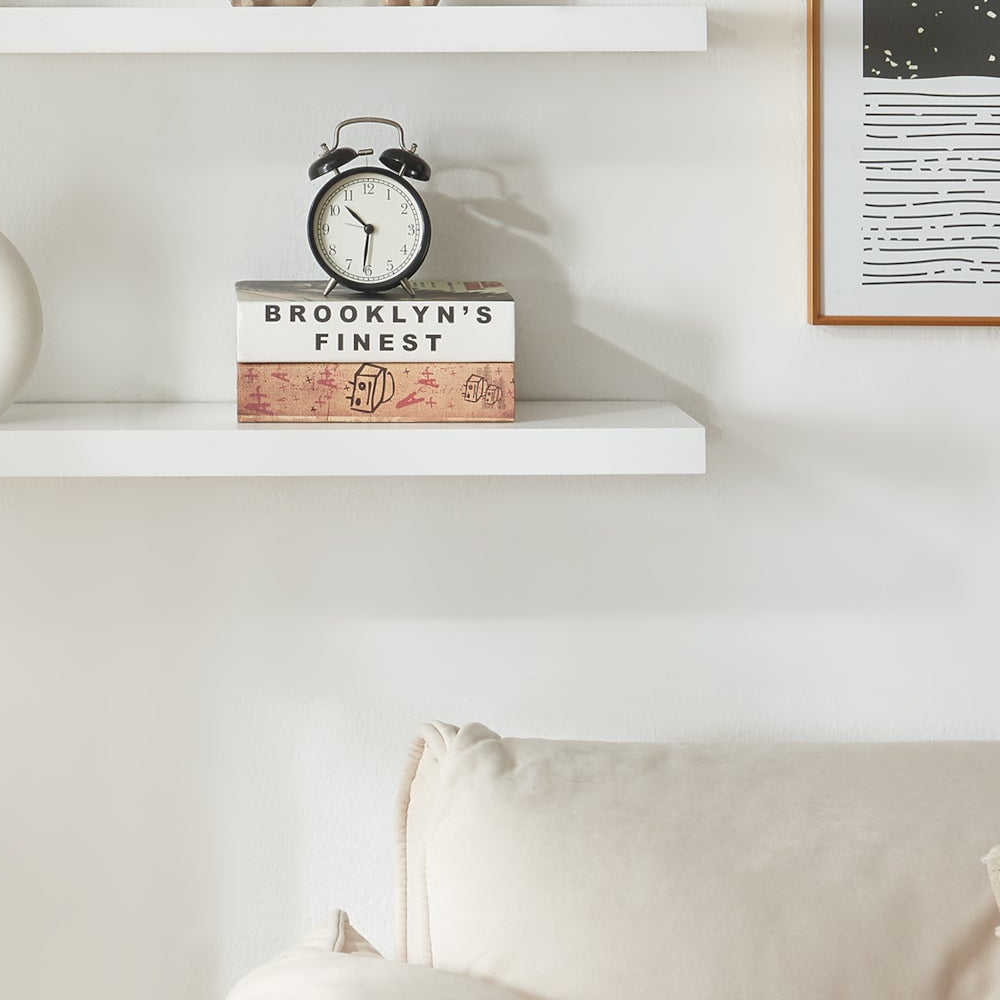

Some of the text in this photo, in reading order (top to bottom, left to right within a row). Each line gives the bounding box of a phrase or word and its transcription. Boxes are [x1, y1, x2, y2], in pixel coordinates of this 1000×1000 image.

[363, 183, 375, 195] 12
[386, 189, 391, 200] 1
[344, 190, 353, 201] 11
[330, 205, 341, 216] 10
[400, 203, 408, 215] 2
[322, 224, 330, 235] 9
[407, 224, 415, 236] 3
[329, 244, 337, 256] 8
[400, 244, 408, 255] 4
[345, 258, 353, 270] 7
[364, 264, 373, 276] 6
[386, 260, 394, 271] 5
[315, 333, 442, 352] FINEST
